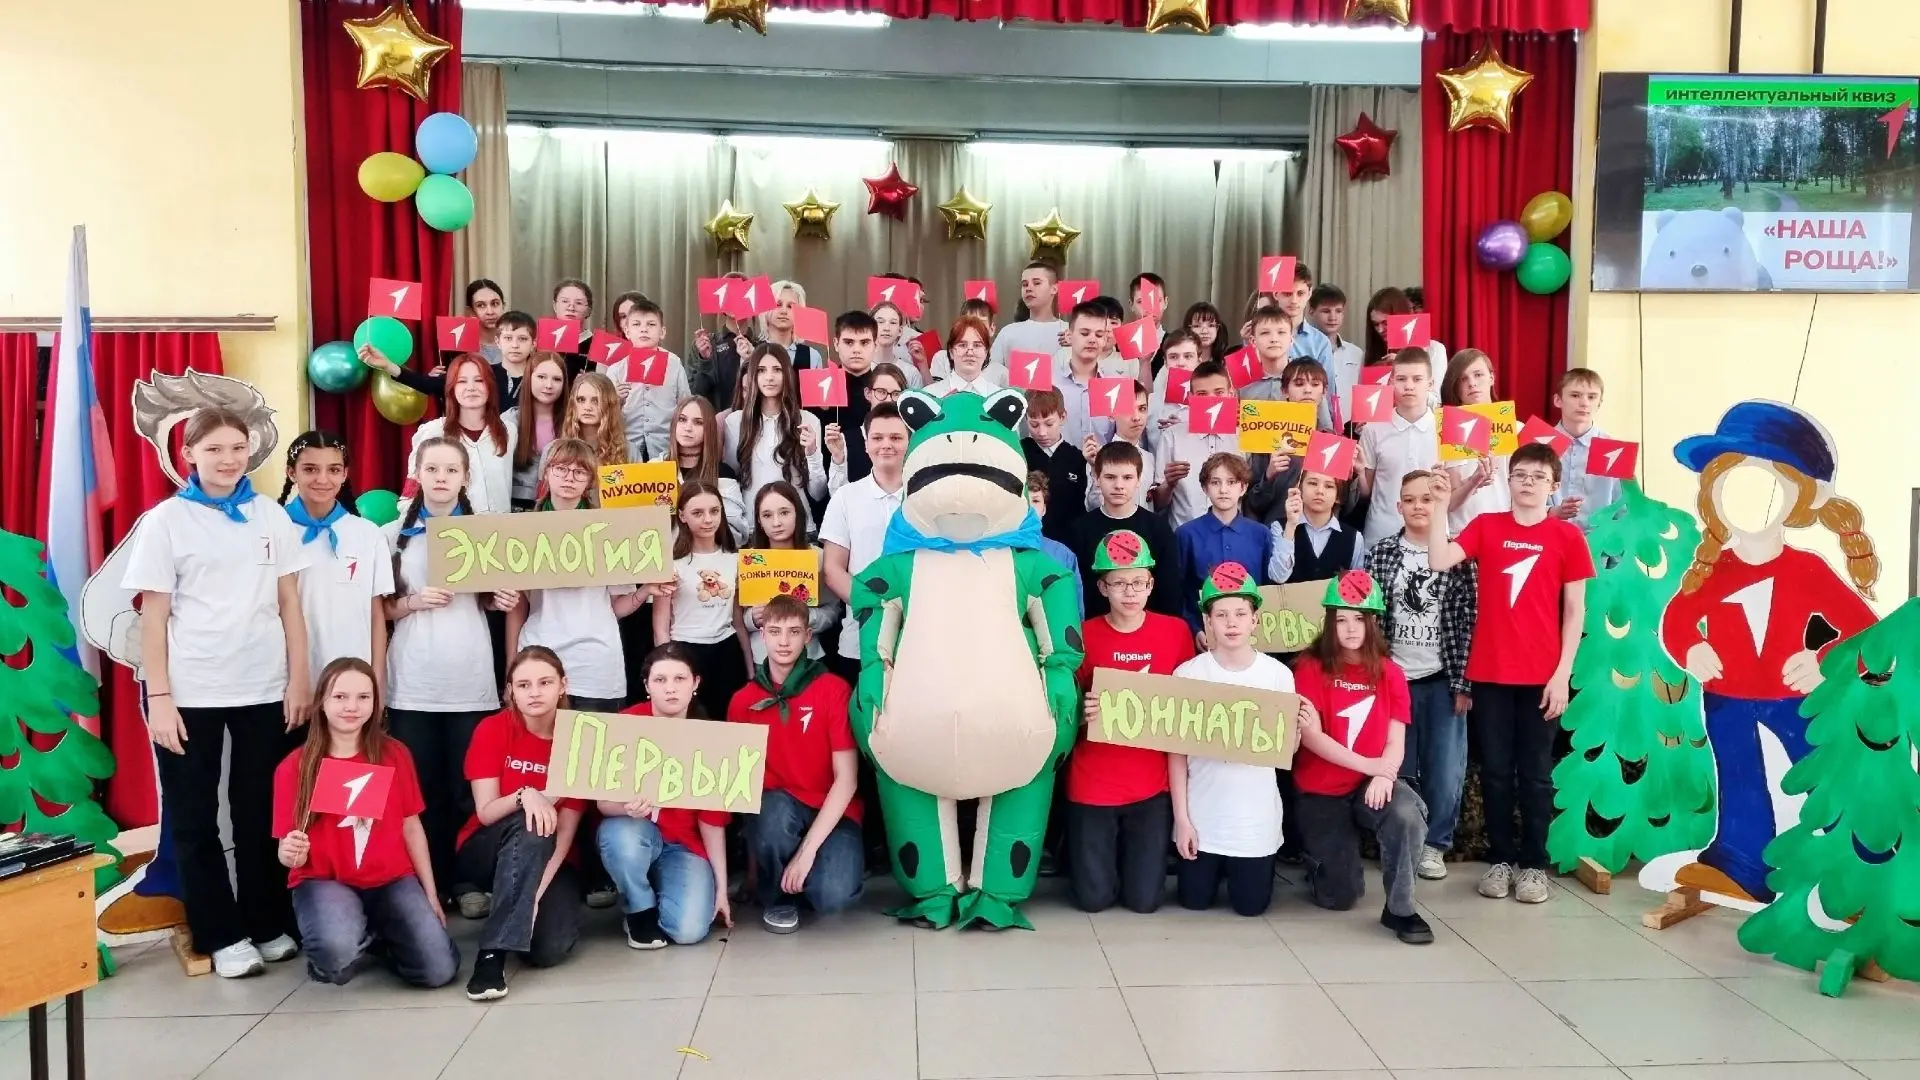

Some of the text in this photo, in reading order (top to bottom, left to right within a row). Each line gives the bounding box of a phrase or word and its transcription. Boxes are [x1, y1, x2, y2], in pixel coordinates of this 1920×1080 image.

[1666, 87, 1896, 104] интеллектуальный квиз
[1764, 219, 1867, 240] «НАША
[1784, 250, 1898, 273] РОЩА!»
[1241, 421, 1313, 435] ВОРОБУШЕК
[601, 482, 676, 499] МУХОМОР
[740, 571, 815, 581] БОЖЬЯ КОРОВКА
[1113, 651, 1152, 664] Первые
[1100, 688, 1286, 753] ЮННАТЫ
